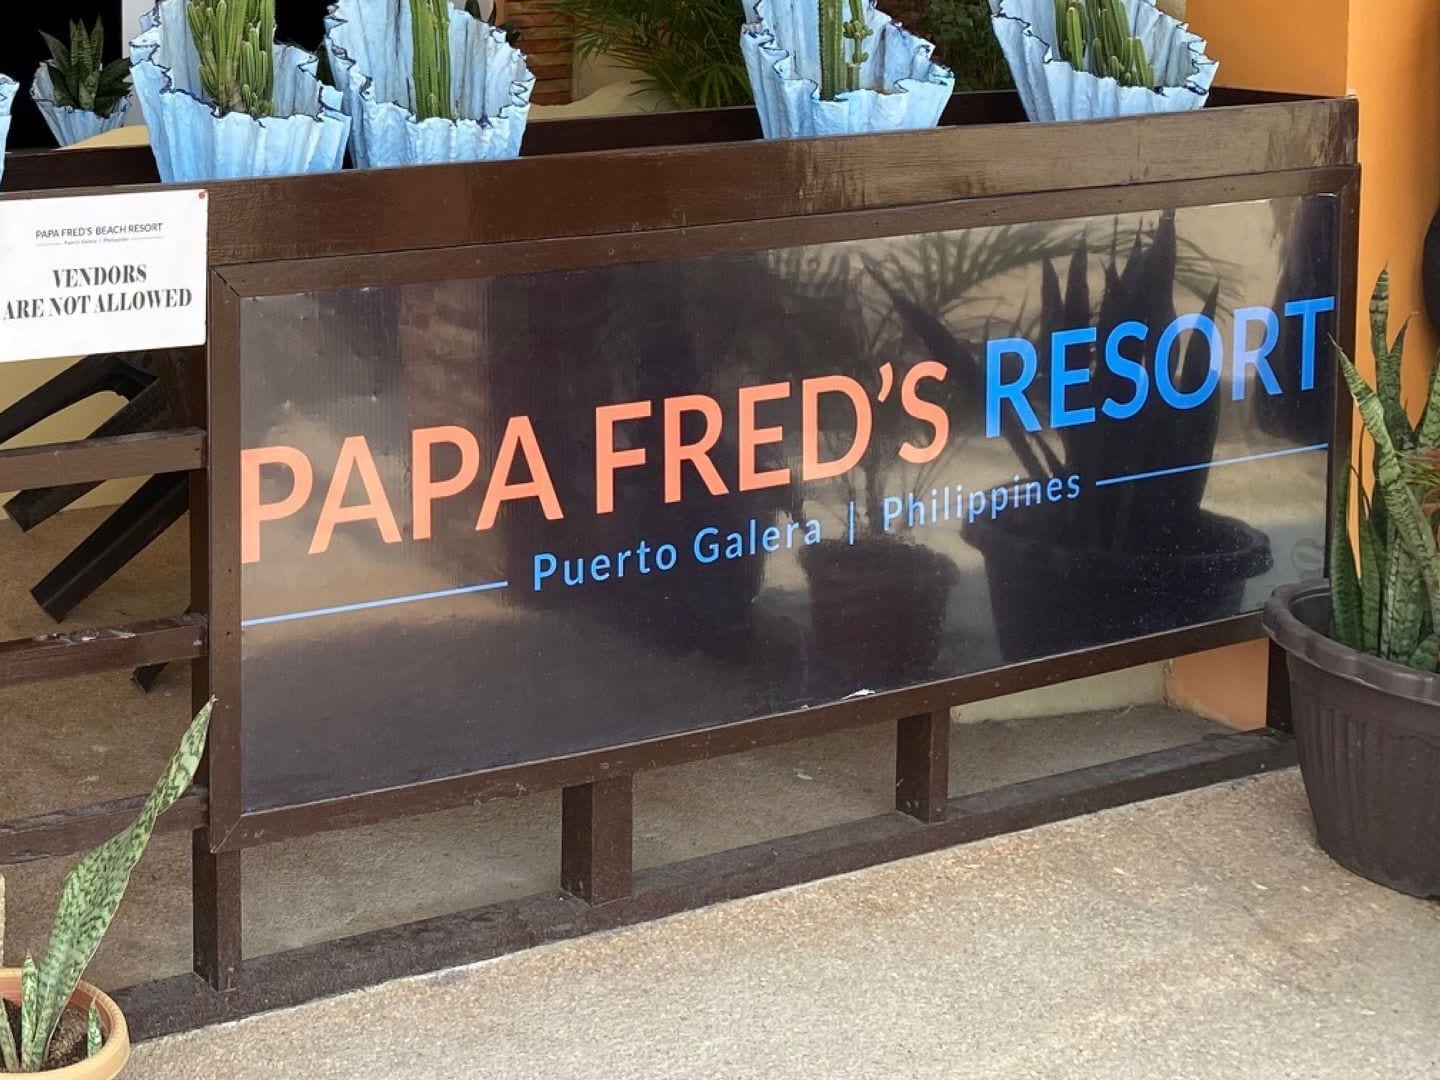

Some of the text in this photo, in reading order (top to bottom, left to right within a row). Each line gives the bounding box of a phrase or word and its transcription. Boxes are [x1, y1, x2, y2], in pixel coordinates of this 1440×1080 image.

[35, 222, 164, 239] PAPA FRED'S BEACH RESORT
[52, 264, 147, 288] VENDORS
[2, 288, 192, 320] ARE NOT ALLOWED
[240, 295, 1335, 564] PAPA FRED'S RESORT
[533, 540, 677, 591] Puerto
[693, 519, 822, 564] Galera
[883, 473, 1081, 532] Philippines
